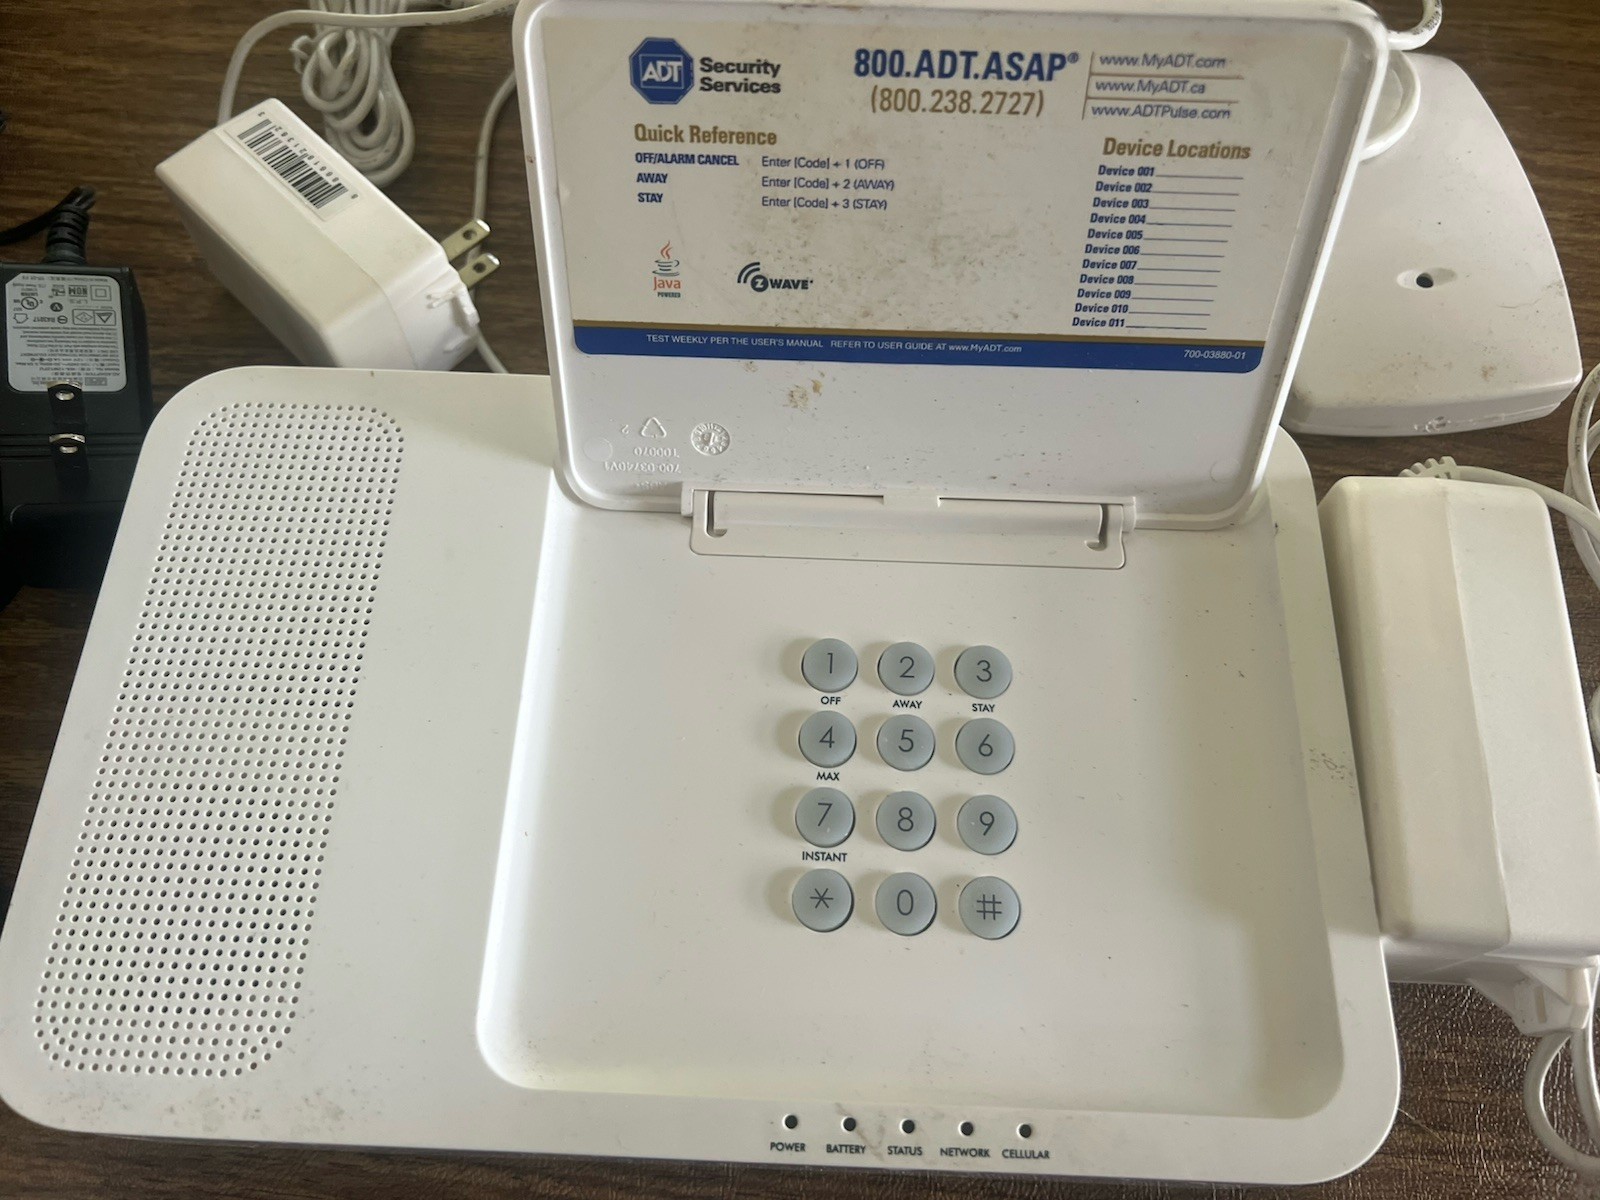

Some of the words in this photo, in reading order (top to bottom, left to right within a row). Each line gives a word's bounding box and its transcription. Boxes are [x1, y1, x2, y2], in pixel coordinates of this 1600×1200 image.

[699, 57, 781, 78] Security
[1099, 53, 1227, 71] www.MyADT.com
[641, 60, 683, 83] ADT
[699, 77, 781, 94] Services
[1095, 80, 1206, 96] www.MyADT.ca
[871, 85, 1045, 118] (800.238.2727)
[1091, 104, 1232, 121] www.ADTPulse.com
[634, 123, 684, 143] Quick
[689, 125, 777, 145] Reference
[1102, 137, 1163, 157] Device
[1166, 139, 1252, 160] Locations
[635, 152, 695, 165] OFF/ALARM
[697, 154, 740, 166] CANCEL
[761, 156, 791, 168] Enter
[794, 157, 830, 170] [Code]
[846, 159, 851, 169] 1
[854, 159, 885, 171] (OFF)
[636, 173, 668, 184] AWAY
[1098, 165, 1135, 176] Device
[1137, 167, 1155, 177] 001
[761, 176, 791, 188] Enter
[794, 177, 830, 190] [Code]
[842, 179, 851, 189] 2
[853, 179, 895, 191] (AWAY)
[1095, 181, 1132, 193] Device
[1134, 183, 1152, 193] 002
[637, 192, 663, 203] STAY
[761, 196, 791, 207] Enter
[794, 197, 829, 210] [Code]
[842, 199, 850, 209] 3
[852, 199, 888, 211] (STAY)
[1092, 197, 1129, 208] Device
[1131, 199, 1149, 209] 003
[1090, 213, 1126, 224] Device
[1128, 215, 1146, 224] 004
[1087, 229, 1123, 240] Device
[1125, 230, 1143, 240] 005
[1084, 244, 1120, 255] Device
[1122, 246, 1140, 255] 006
[1082, 259, 1117, 270] Device
[1119, 261, 1138, 270] 007
[653, 276, 681, 291] Java
[769, 278, 809, 290] WAVE
[1079, 274, 1115, 285] Device
[1117, 275, 1134, 285] 008
[69, 286, 88, 296] NOM
[1077, 289, 1112, 299] Device
[1114, 290, 1131, 299] 009
[1074, 303, 1109, 313] Device
[1111, 304, 1129, 313] 010
[1072, 317, 1107, 327] Device
[1108, 318, 1125, 327] 011
[647, 334, 670, 343] TEST
[671, 335, 709, 344] WEEKLY
[710, 336, 729, 345] PER
[731, 337, 749, 345] THE
[751, 337, 785, 346] USER'S
[786, 339, 823, 348] MANUAL
[830, 340, 862, 349] REFER
[863, 341, 876, 350] TO
[877, 342, 903, 350] USER
[905, 342, 933, 351] GUIDE
[935, 343, 946, 351] AT
[948, 344, 1022, 353] www.MyADT.com
[1183, 350, 1246, 360] 700-03880-01
[827, 652, 834, 674] 1
[899, 656, 915, 678] 2
[976, 659, 992, 682] 3
[820, 696, 841, 706] OFF
[892, 700, 922, 709] AWAY
[972, 703, 995, 713] STAY
[819, 726, 835, 748] 4
[898, 729, 914, 752] 5
[978, 734, 993, 757] 6
[816, 772, 840, 781] MAX
[817, 802, 833, 827] 7
[897, 806, 914, 832] 8
[979, 811, 995, 836] 9
[802, 851, 848, 862] INSTANT
[896, 889, 914, 916] 0
[770, 1142, 806, 1152] POWER
[826, 1144, 866, 1154] BATTERY
[887, 1146, 923, 1156] STATUS
[940, 1147, 990, 1158] NETWORK
[1002, 1149, 1050, 1159] CELLULAR
